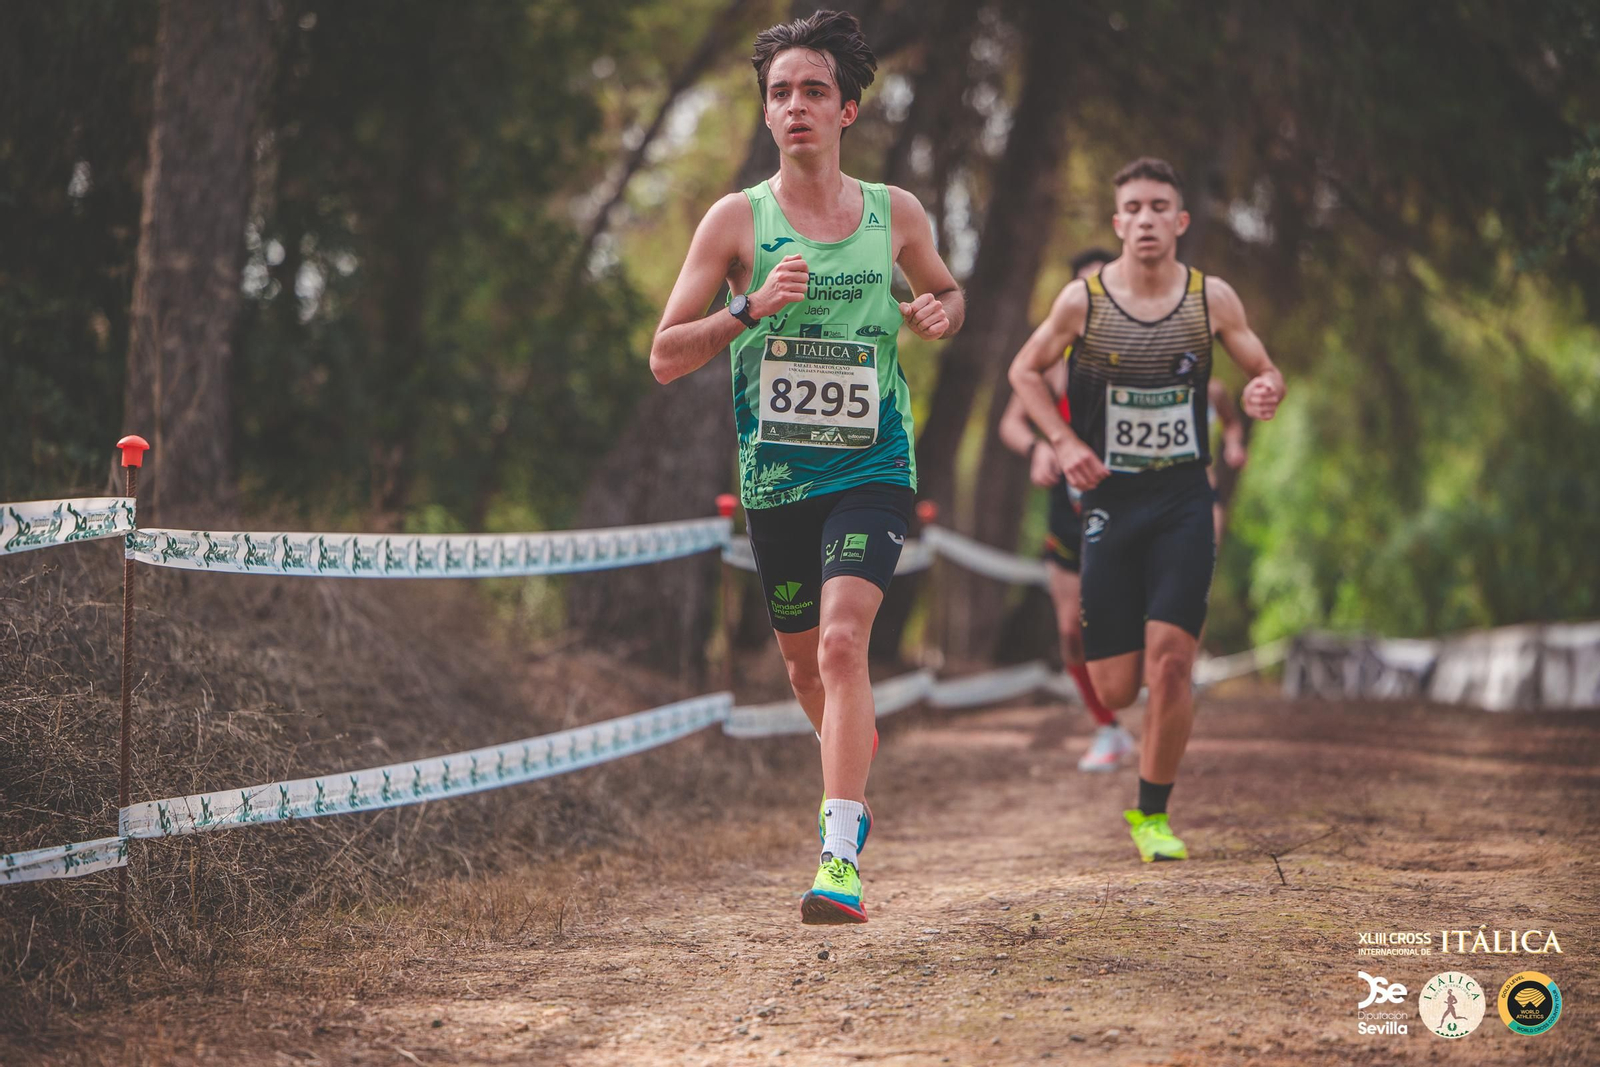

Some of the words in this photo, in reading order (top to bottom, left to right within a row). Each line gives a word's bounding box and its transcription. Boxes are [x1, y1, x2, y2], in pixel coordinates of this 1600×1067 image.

[807, 269, 883, 286] Fundación
[807, 286, 863, 303] Unicaja
[804, 305, 830, 316] Jaén
[795, 342, 851, 358] ITÁLICA
[769, 378, 870, 418] 8295
[1116, 419, 1189, 449] 8258
[770, 600, 813, 610] Fundación
[772, 607, 803, 616] Unicaja
